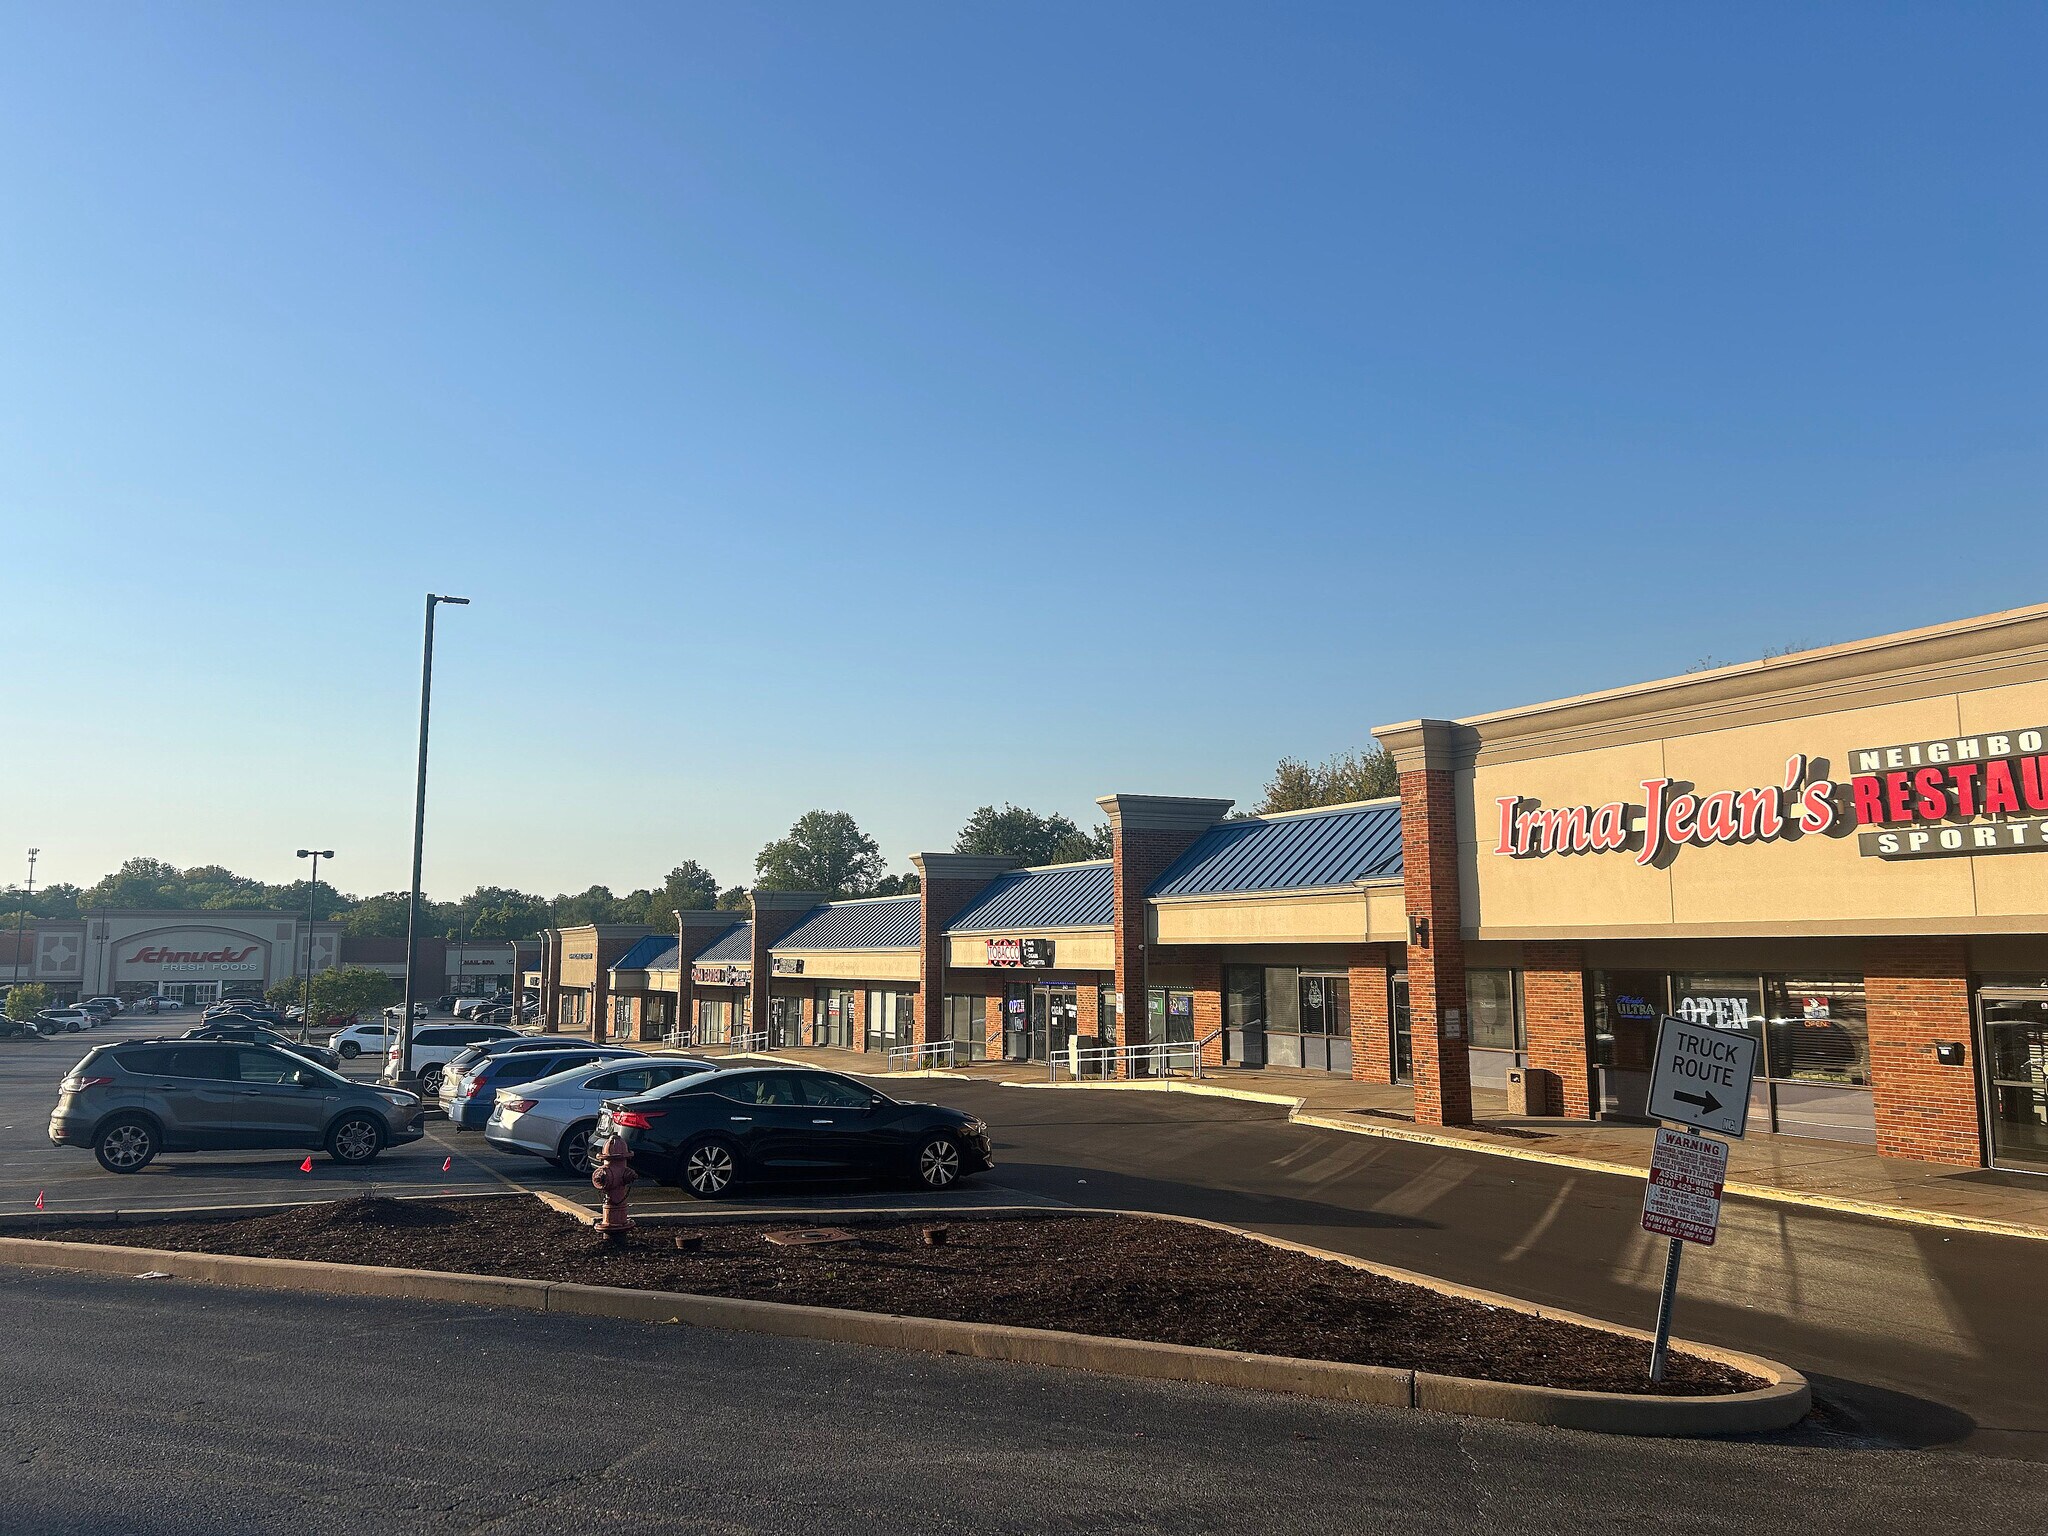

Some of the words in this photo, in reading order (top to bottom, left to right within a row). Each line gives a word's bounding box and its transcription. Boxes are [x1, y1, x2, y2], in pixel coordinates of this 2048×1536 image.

[1494, 796, 1626, 856] Irma
[1636, 754, 1839, 867] Jean's
[126, 946, 259, 964] Schnucks
[989, 947, 1019, 960] TOBACCO
[162, 963, 206, 971] FRESH
[212, 963, 257, 971] FOODS
[1009, 999, 1025, 1014] OPEN
[1617, 1004, 1655, 1015] ULTRA
[1681, 997, 1749, 1030] OPEN
[1677, 1032, 1739, 1065] TRUCK
[1672, 1055, 1734, 1088] ROUTE
[1665, 1133, 1719, 1155] WARNING
[1655, 1177, 1674, 1187] (314)
[1676, 1182, 1714, 1197] 429-5800
[1658, 1169, 1682, 1181] ASSET
[1685, 1176, 1714, 1189] TOWING
[1645, 1213, 1673, 1225] TOWING
[1675, 1220, 1713, 1235] ENFORCED
